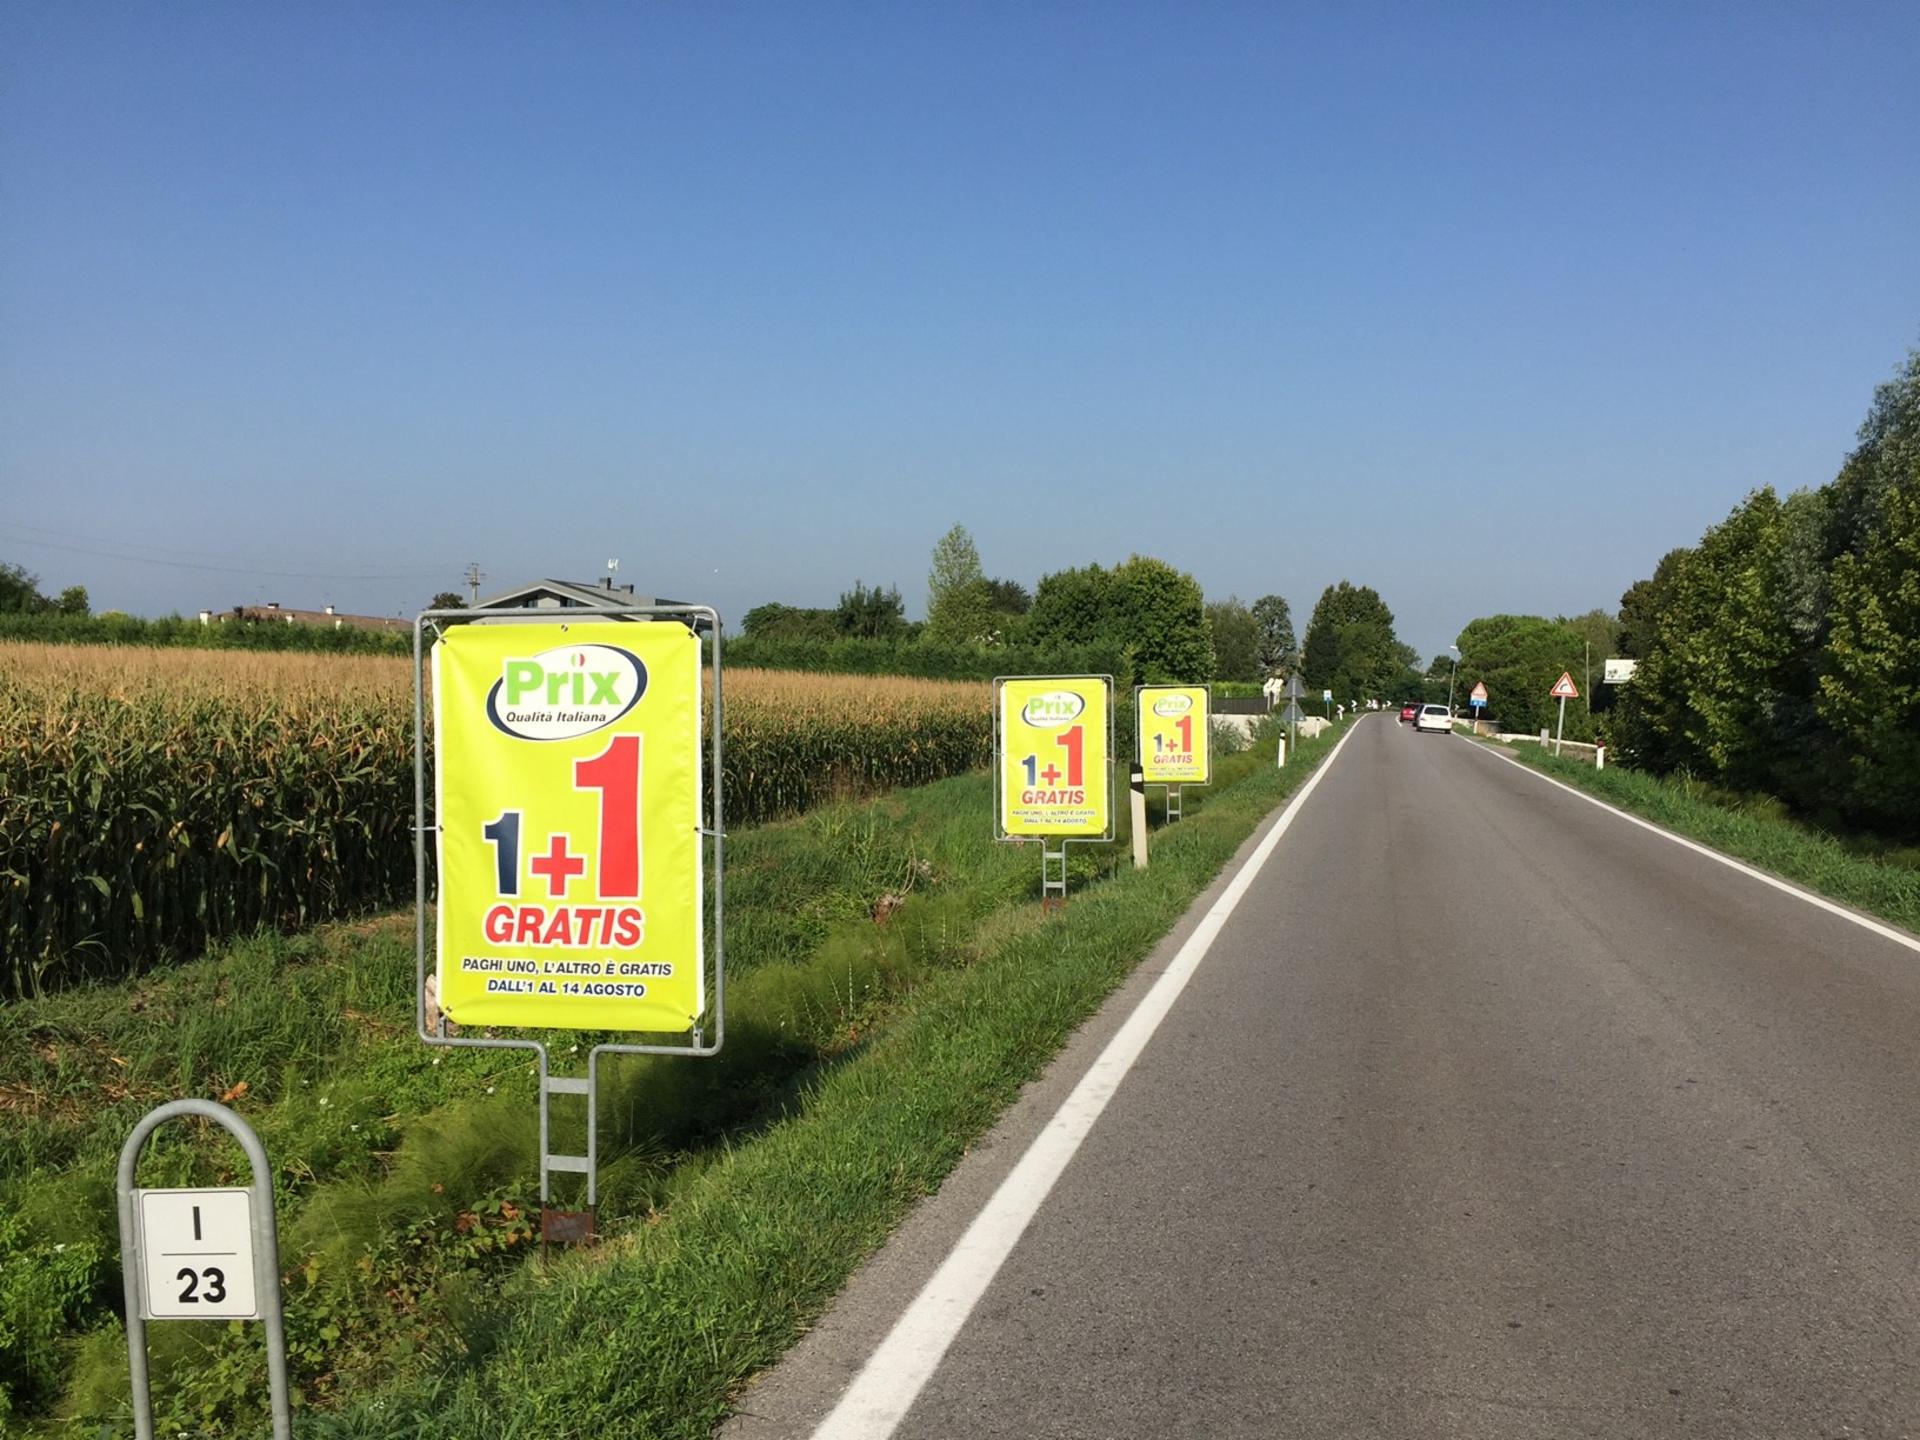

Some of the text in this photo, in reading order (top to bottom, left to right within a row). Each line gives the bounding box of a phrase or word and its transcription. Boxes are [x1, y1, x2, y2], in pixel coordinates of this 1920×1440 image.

[506, 653, 622, 706] Prix
[1030, 695, 1074, 714] Prix
[1159, 696, 1186, 709] Prix
[506, 711, 606, 723] Qualità Italiana
[1153, 755, 1192, 764] GRATIS
[1022, 790, 1084, 804] GRATIS
[485, 907, 642, 946] GRATIS
[463, 958, 502, 970] PAGHI
[507, 959, 539, 975] UNO,
[605, 960, 615, 975] È
[620, 963, 672, 976] GRATIS
[488, 979, 644, 996] DALL'1 AL 14 AGOSTO
[176, 1267, 227, 1303] 23
